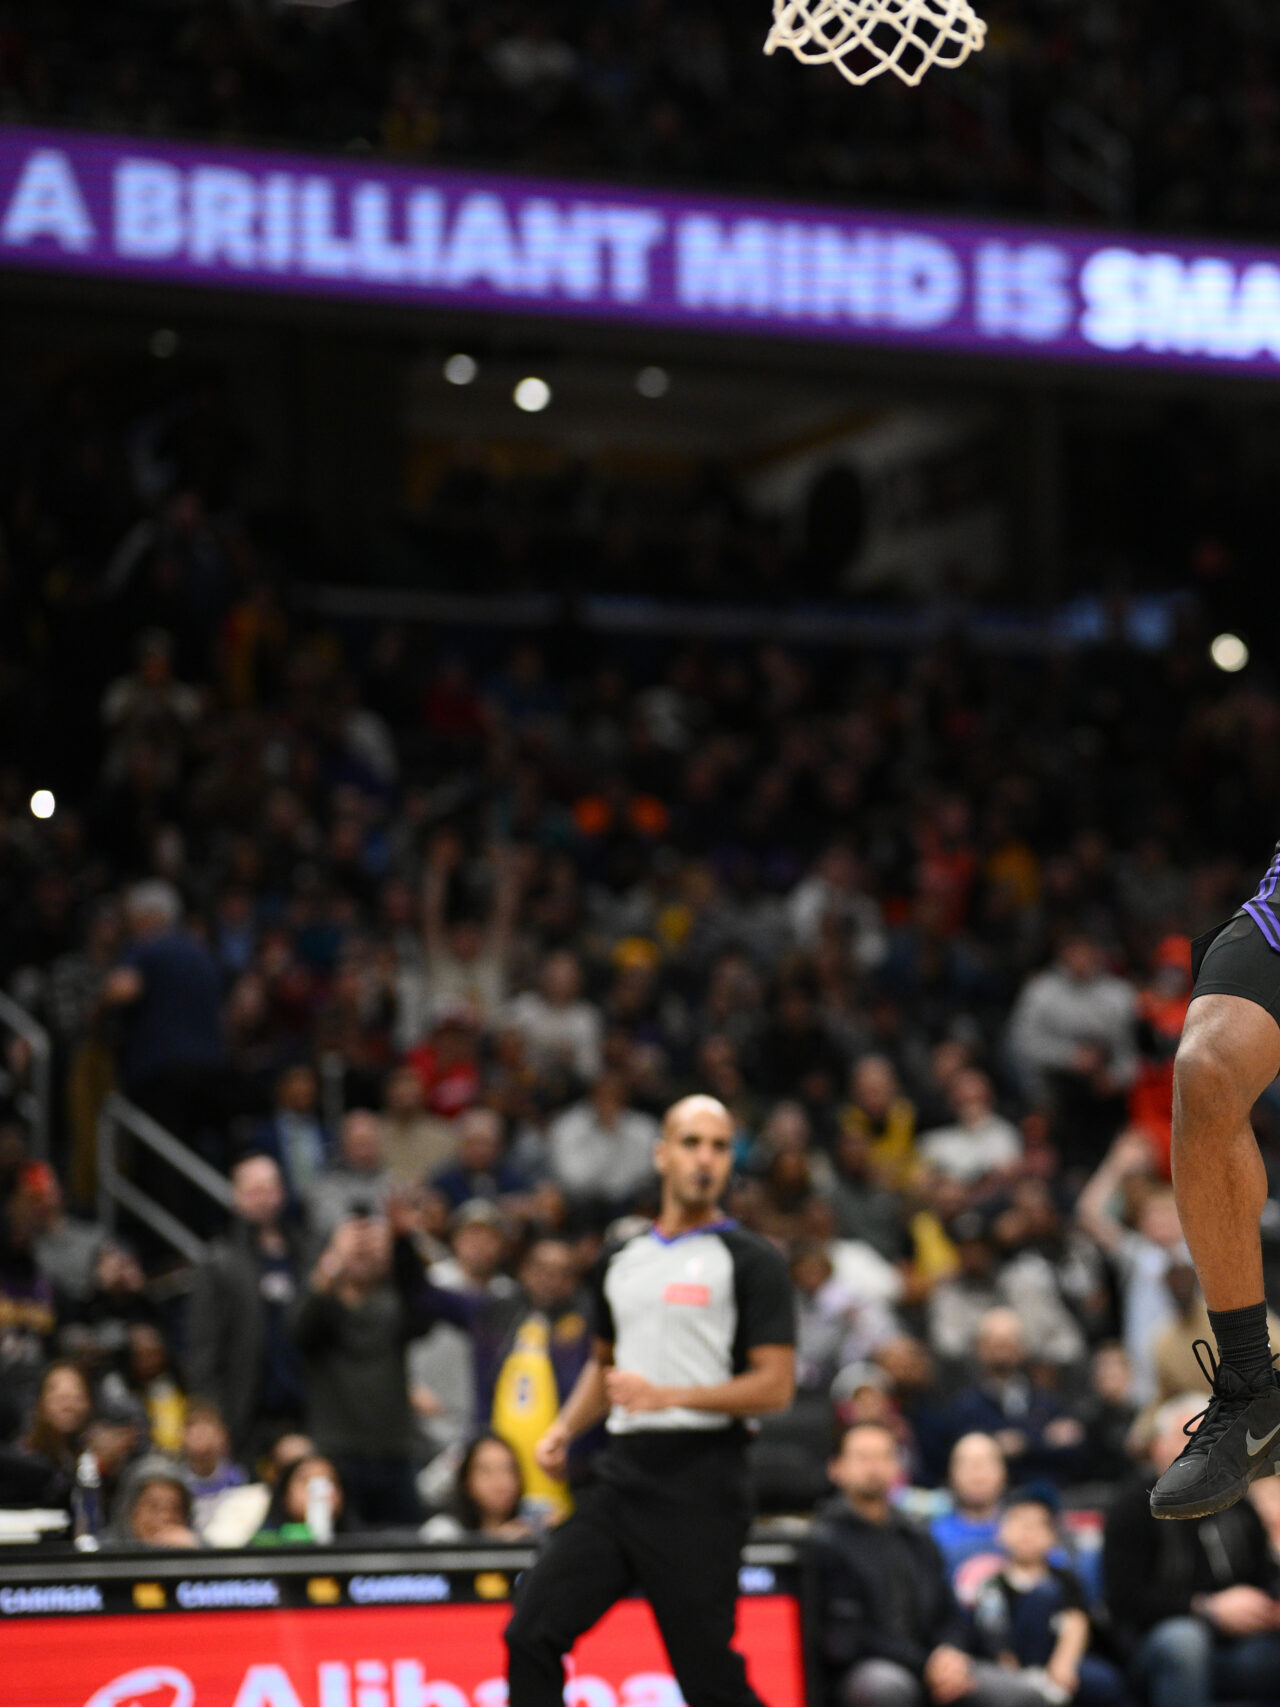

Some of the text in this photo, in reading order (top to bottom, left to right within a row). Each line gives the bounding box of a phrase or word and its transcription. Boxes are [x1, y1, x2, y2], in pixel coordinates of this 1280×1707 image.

[3, 149, 96, 252] A
[113, 157, 666, 304] BRILLIANT
[674, 213, 965, 329] MIND
[974, 241, 1072, 343] IS
